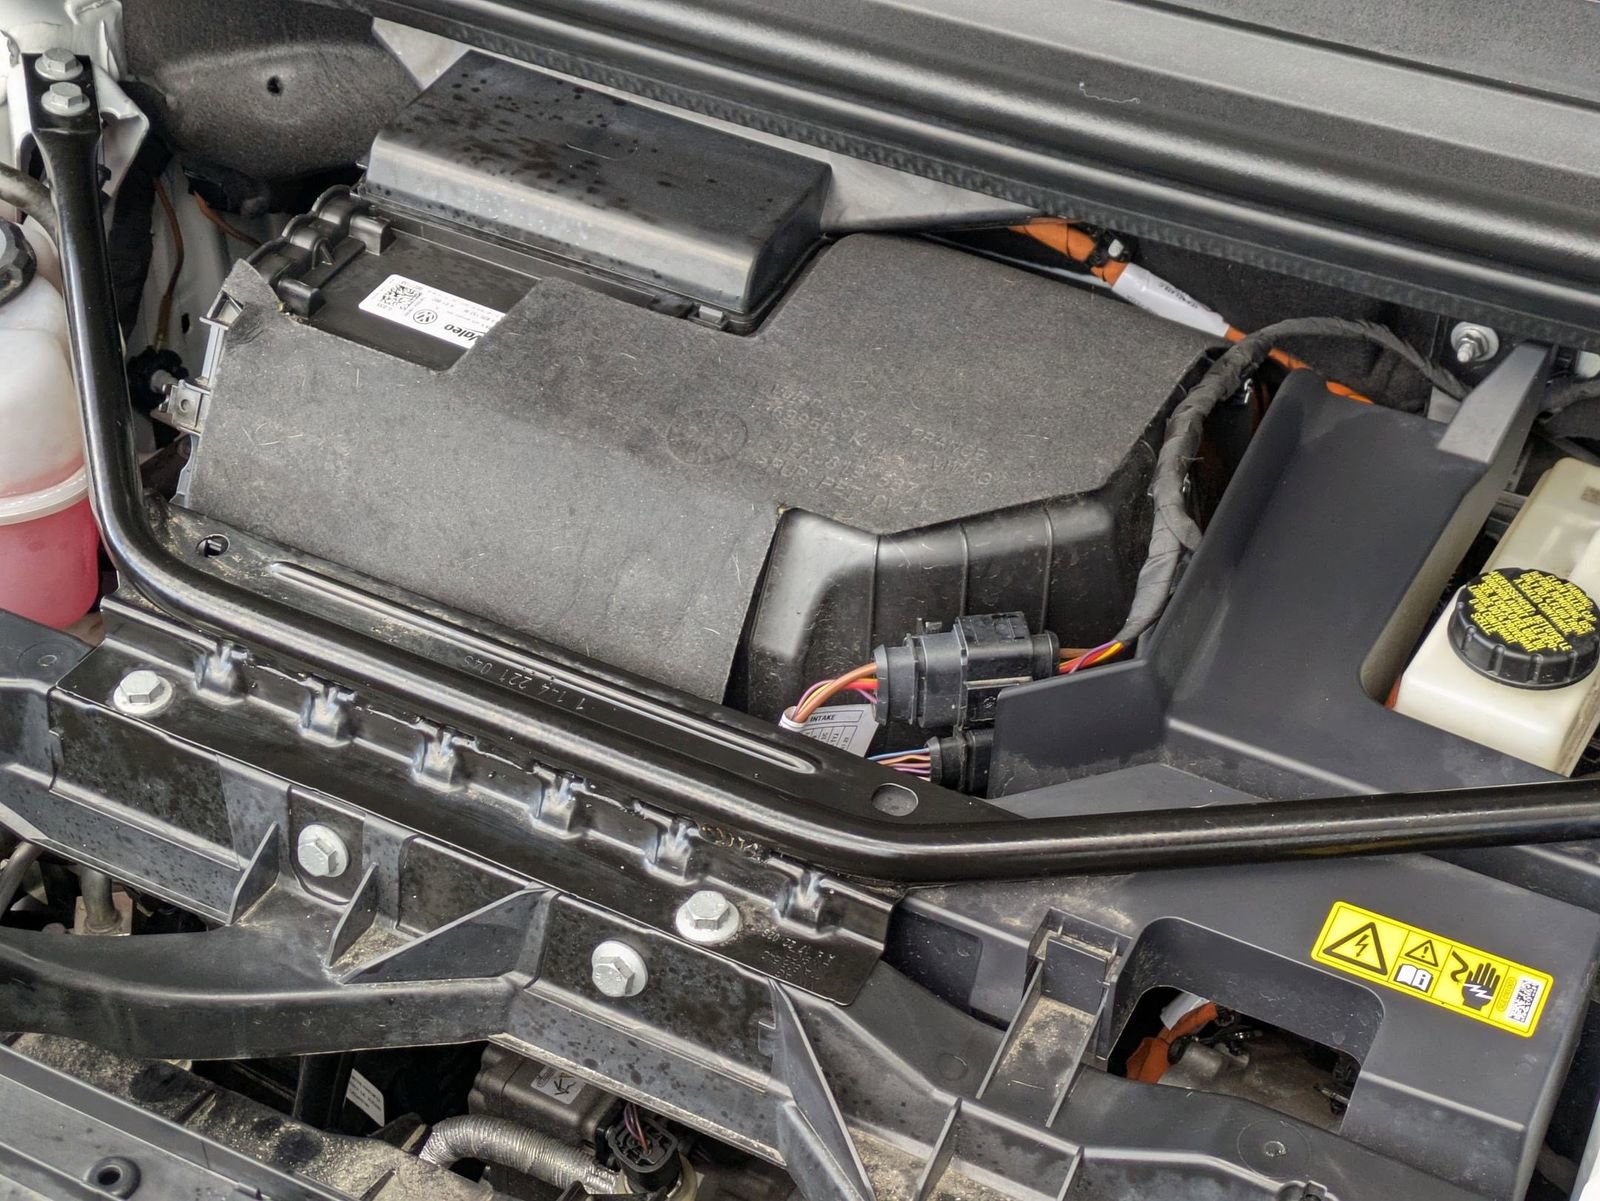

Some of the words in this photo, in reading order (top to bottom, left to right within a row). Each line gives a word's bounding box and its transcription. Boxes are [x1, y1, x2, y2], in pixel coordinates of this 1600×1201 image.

[1518, 572, 1539, 588] ONLY
[1532, 586, 1550, 599] DOT
[1480, 574, 1511, 601] BOUCHON
[1504, 598, 1528, 618] AVANT
[1521, 616, 1536, 627] DE
[1529, 624, 1544, 634] LE
[1516, 582, 1542, 604] SEALED
[1536, 601, 1573, 635] CONTAINER.
[1528, 569, 1555, 592] BEFORE
[1548, 589, 1583, 620] REMOVING.
[1577, 618, 1595, 633] USE
[1543, 596, 1554, 604] 4
[1544, 574, 1567, 593] CLEAN
[1561, 591, 1585, 611] FILLER
[1580, 609, 1597, 622] CAP
[1563, 581, 1595, 609] WARNING:
[1466, 584, 1493, 607] LIQUIDE
[1500, 619, 1537, 653] PROVENANT
[1487, 569, 1538, 616] AVERTISSEMENT:
[1530, 613, 1565, 643] NETTOYER
[1558, 641, 1573, 651] LE
[1547, 601, 1570, 619] FLUID
[1480, 610, 1517, 644] CONTENANT
[1520, 627, 1539, 641] QUE
[1532, 638, 1547, 650] DU
[1563, 617, 1586, 635] FROM
[810, 714, 835, 722] INTAKE
